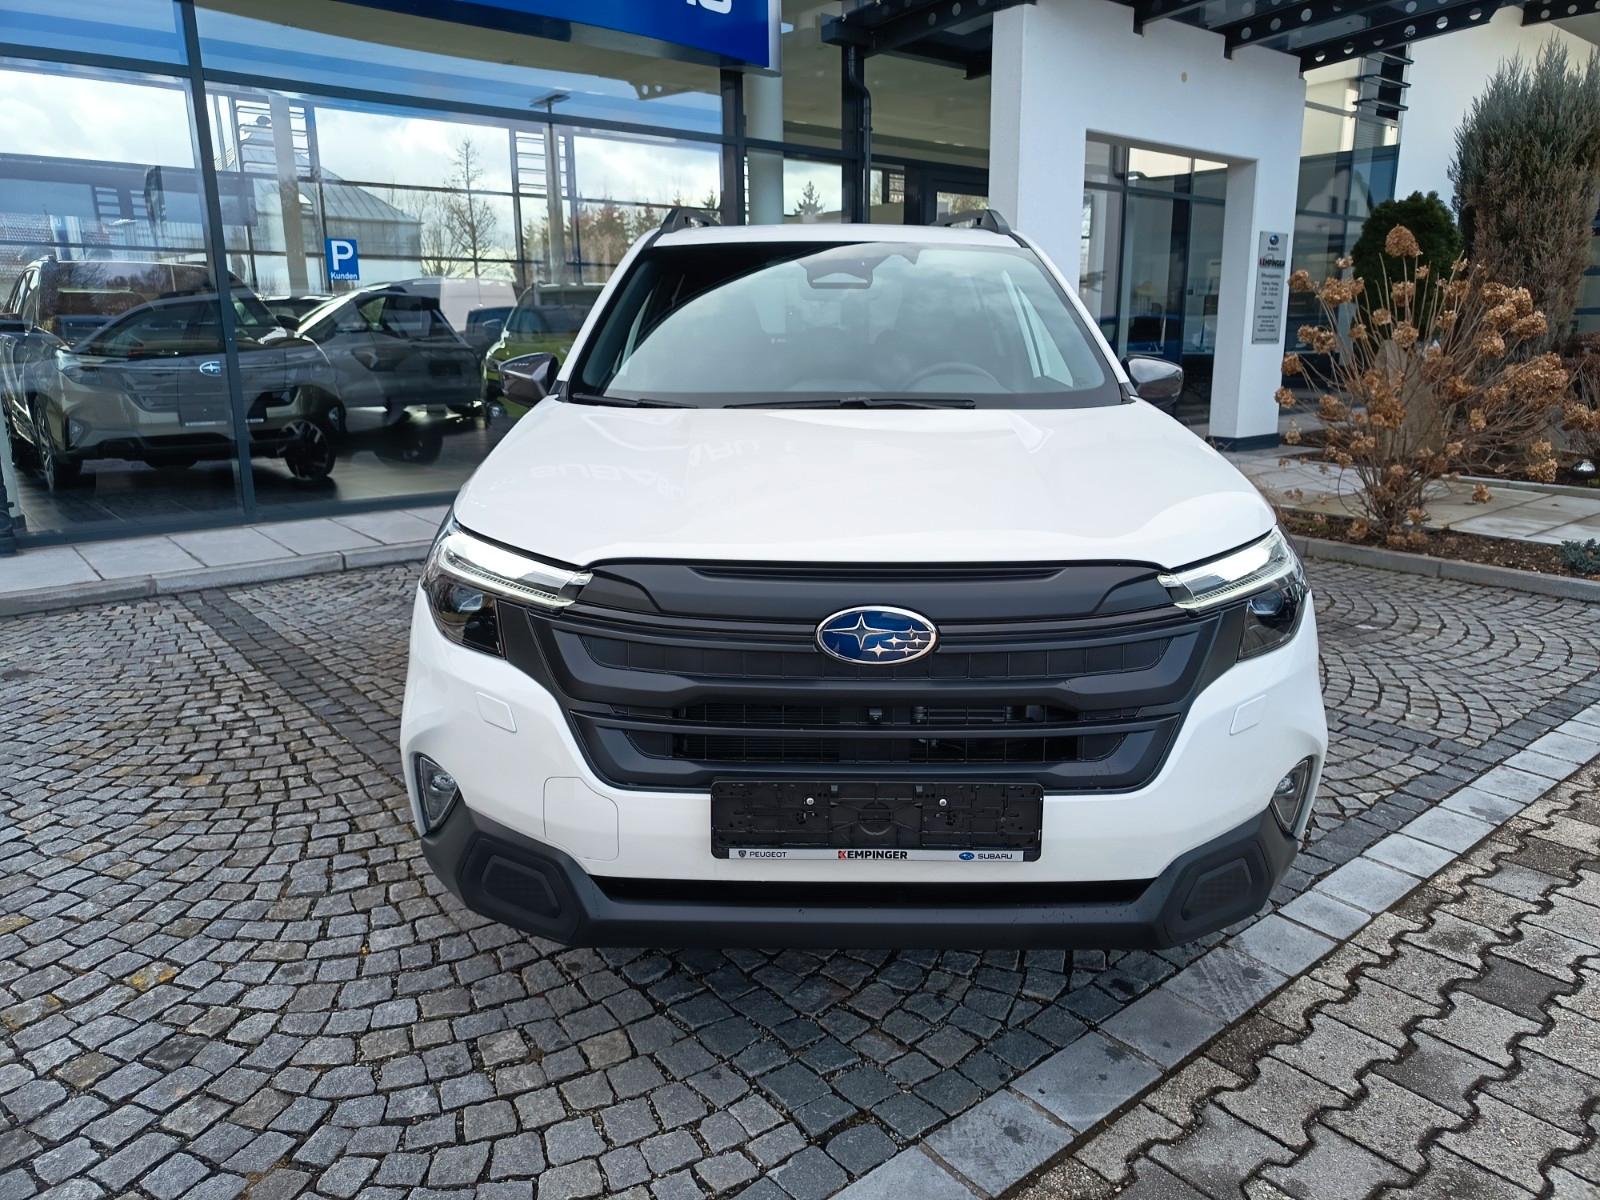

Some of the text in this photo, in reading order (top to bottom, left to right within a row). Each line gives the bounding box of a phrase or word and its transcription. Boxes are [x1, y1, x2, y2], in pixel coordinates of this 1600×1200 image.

[331, 240, 354, 271] P
[330, 272, 358, 280] Kunden
[838, 850, 908, 860] KEMPINGER
